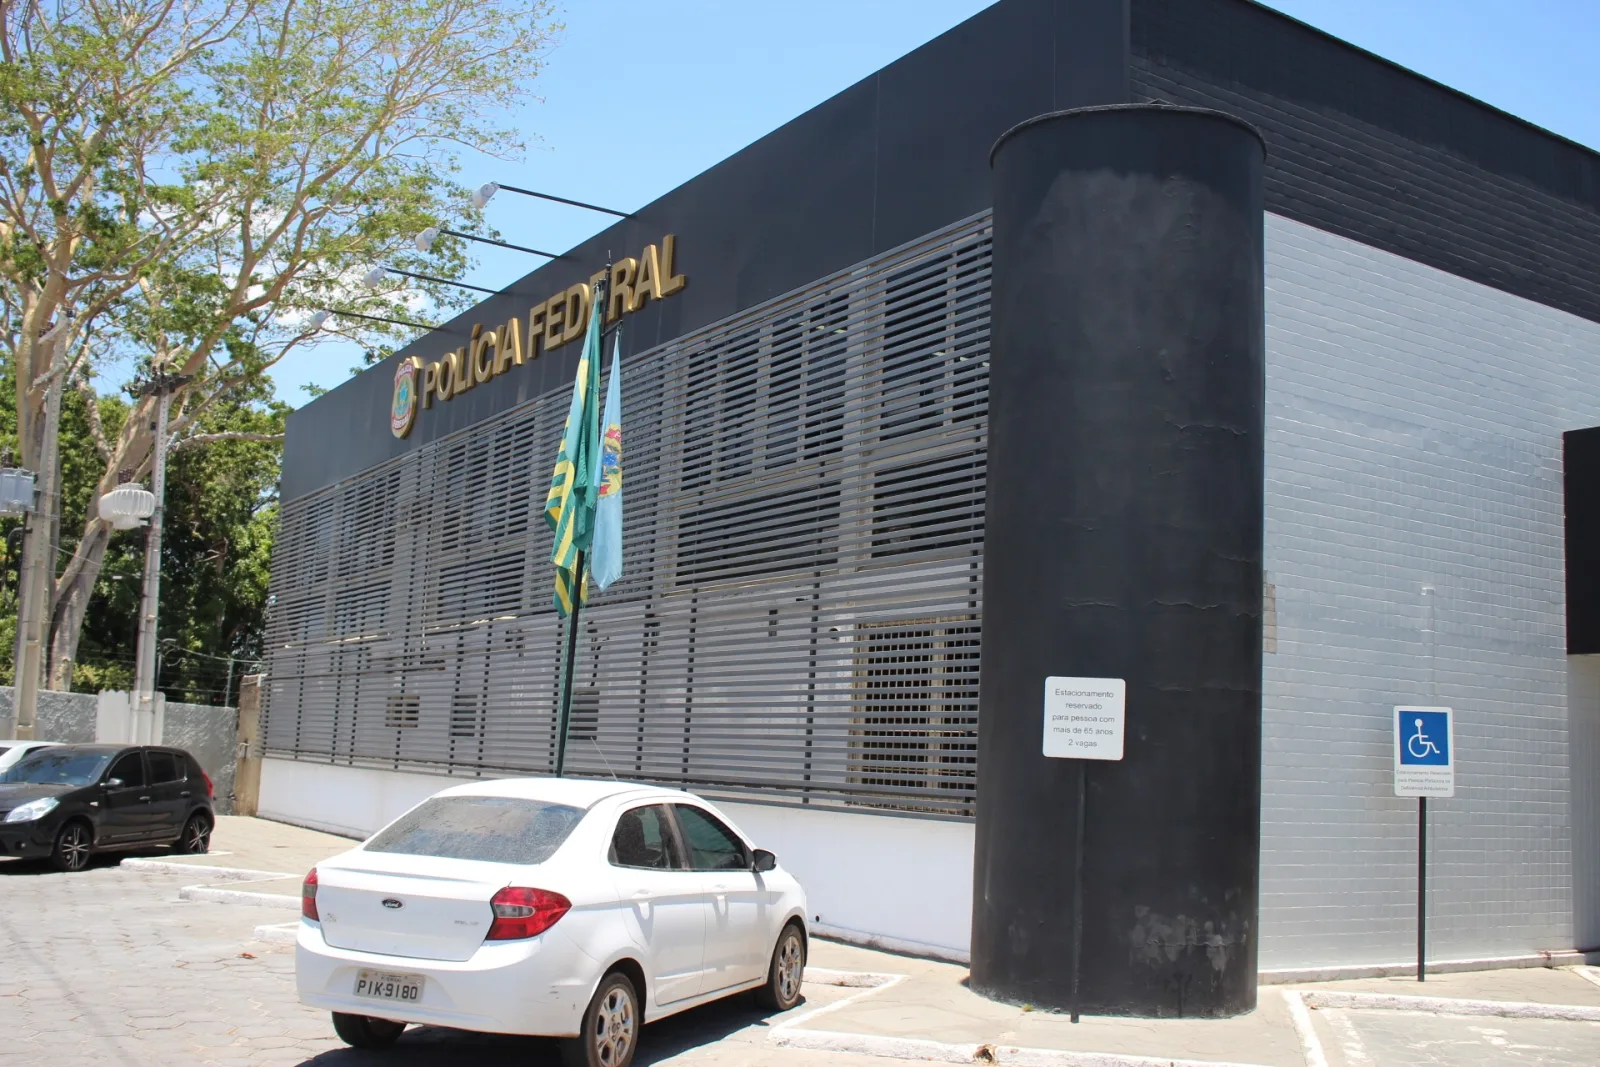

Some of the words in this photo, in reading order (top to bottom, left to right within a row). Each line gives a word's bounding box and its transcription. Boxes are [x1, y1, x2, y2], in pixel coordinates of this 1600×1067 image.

[422, 318, 522, 409] POLÍCIA
[527, 234, 686, 360] FEDERAL
[1054, 688, 1114, 698] Estacionamento
[1065, 702, 1103, 710] reservado
[1051, 714, 1069, 722] para
[1070, 715, 1098, 723] pessoa
[1052, 726, 1071, 734] mais
[1072, 726, 1082, 735] de
[1083, 727, 1093, 735] 65
[1095, 728, 1114, 736] anos
[1068, 738, 1074, 746] 2
[1075, 740, 1098, 749] vagas
